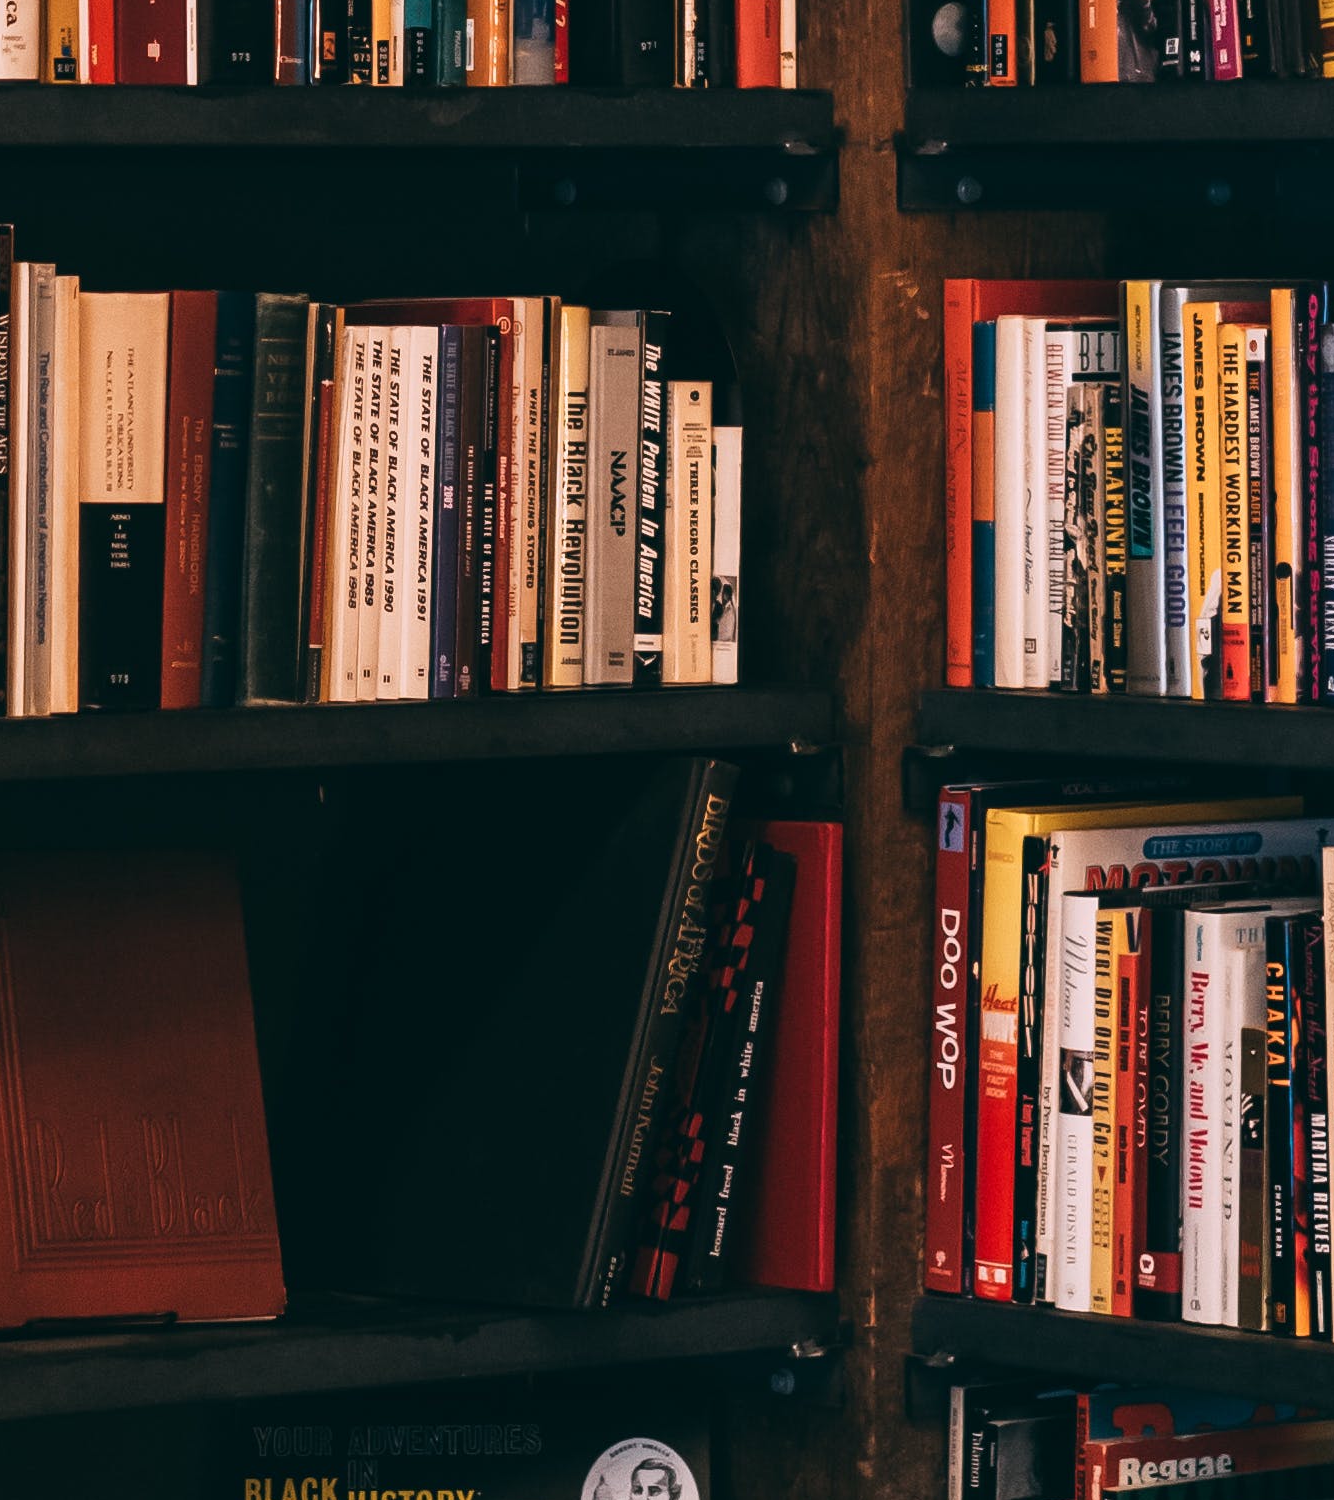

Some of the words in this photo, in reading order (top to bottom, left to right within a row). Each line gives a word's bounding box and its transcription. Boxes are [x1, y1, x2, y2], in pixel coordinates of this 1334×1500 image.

[611, 451, 628, 537] NAACP
[689, 461, 699, 503] THREE
[1105, 427, 1125, 575] BELAFONTE
[689, 507, 699, 555] NEGRO
[689, 560, 699, 624] CLASSICS
[940, 908, 961, 989] DOO
[936, 1003, 958, 1089] WOP
[1118, 1455, 1236, 1489] Reggae
